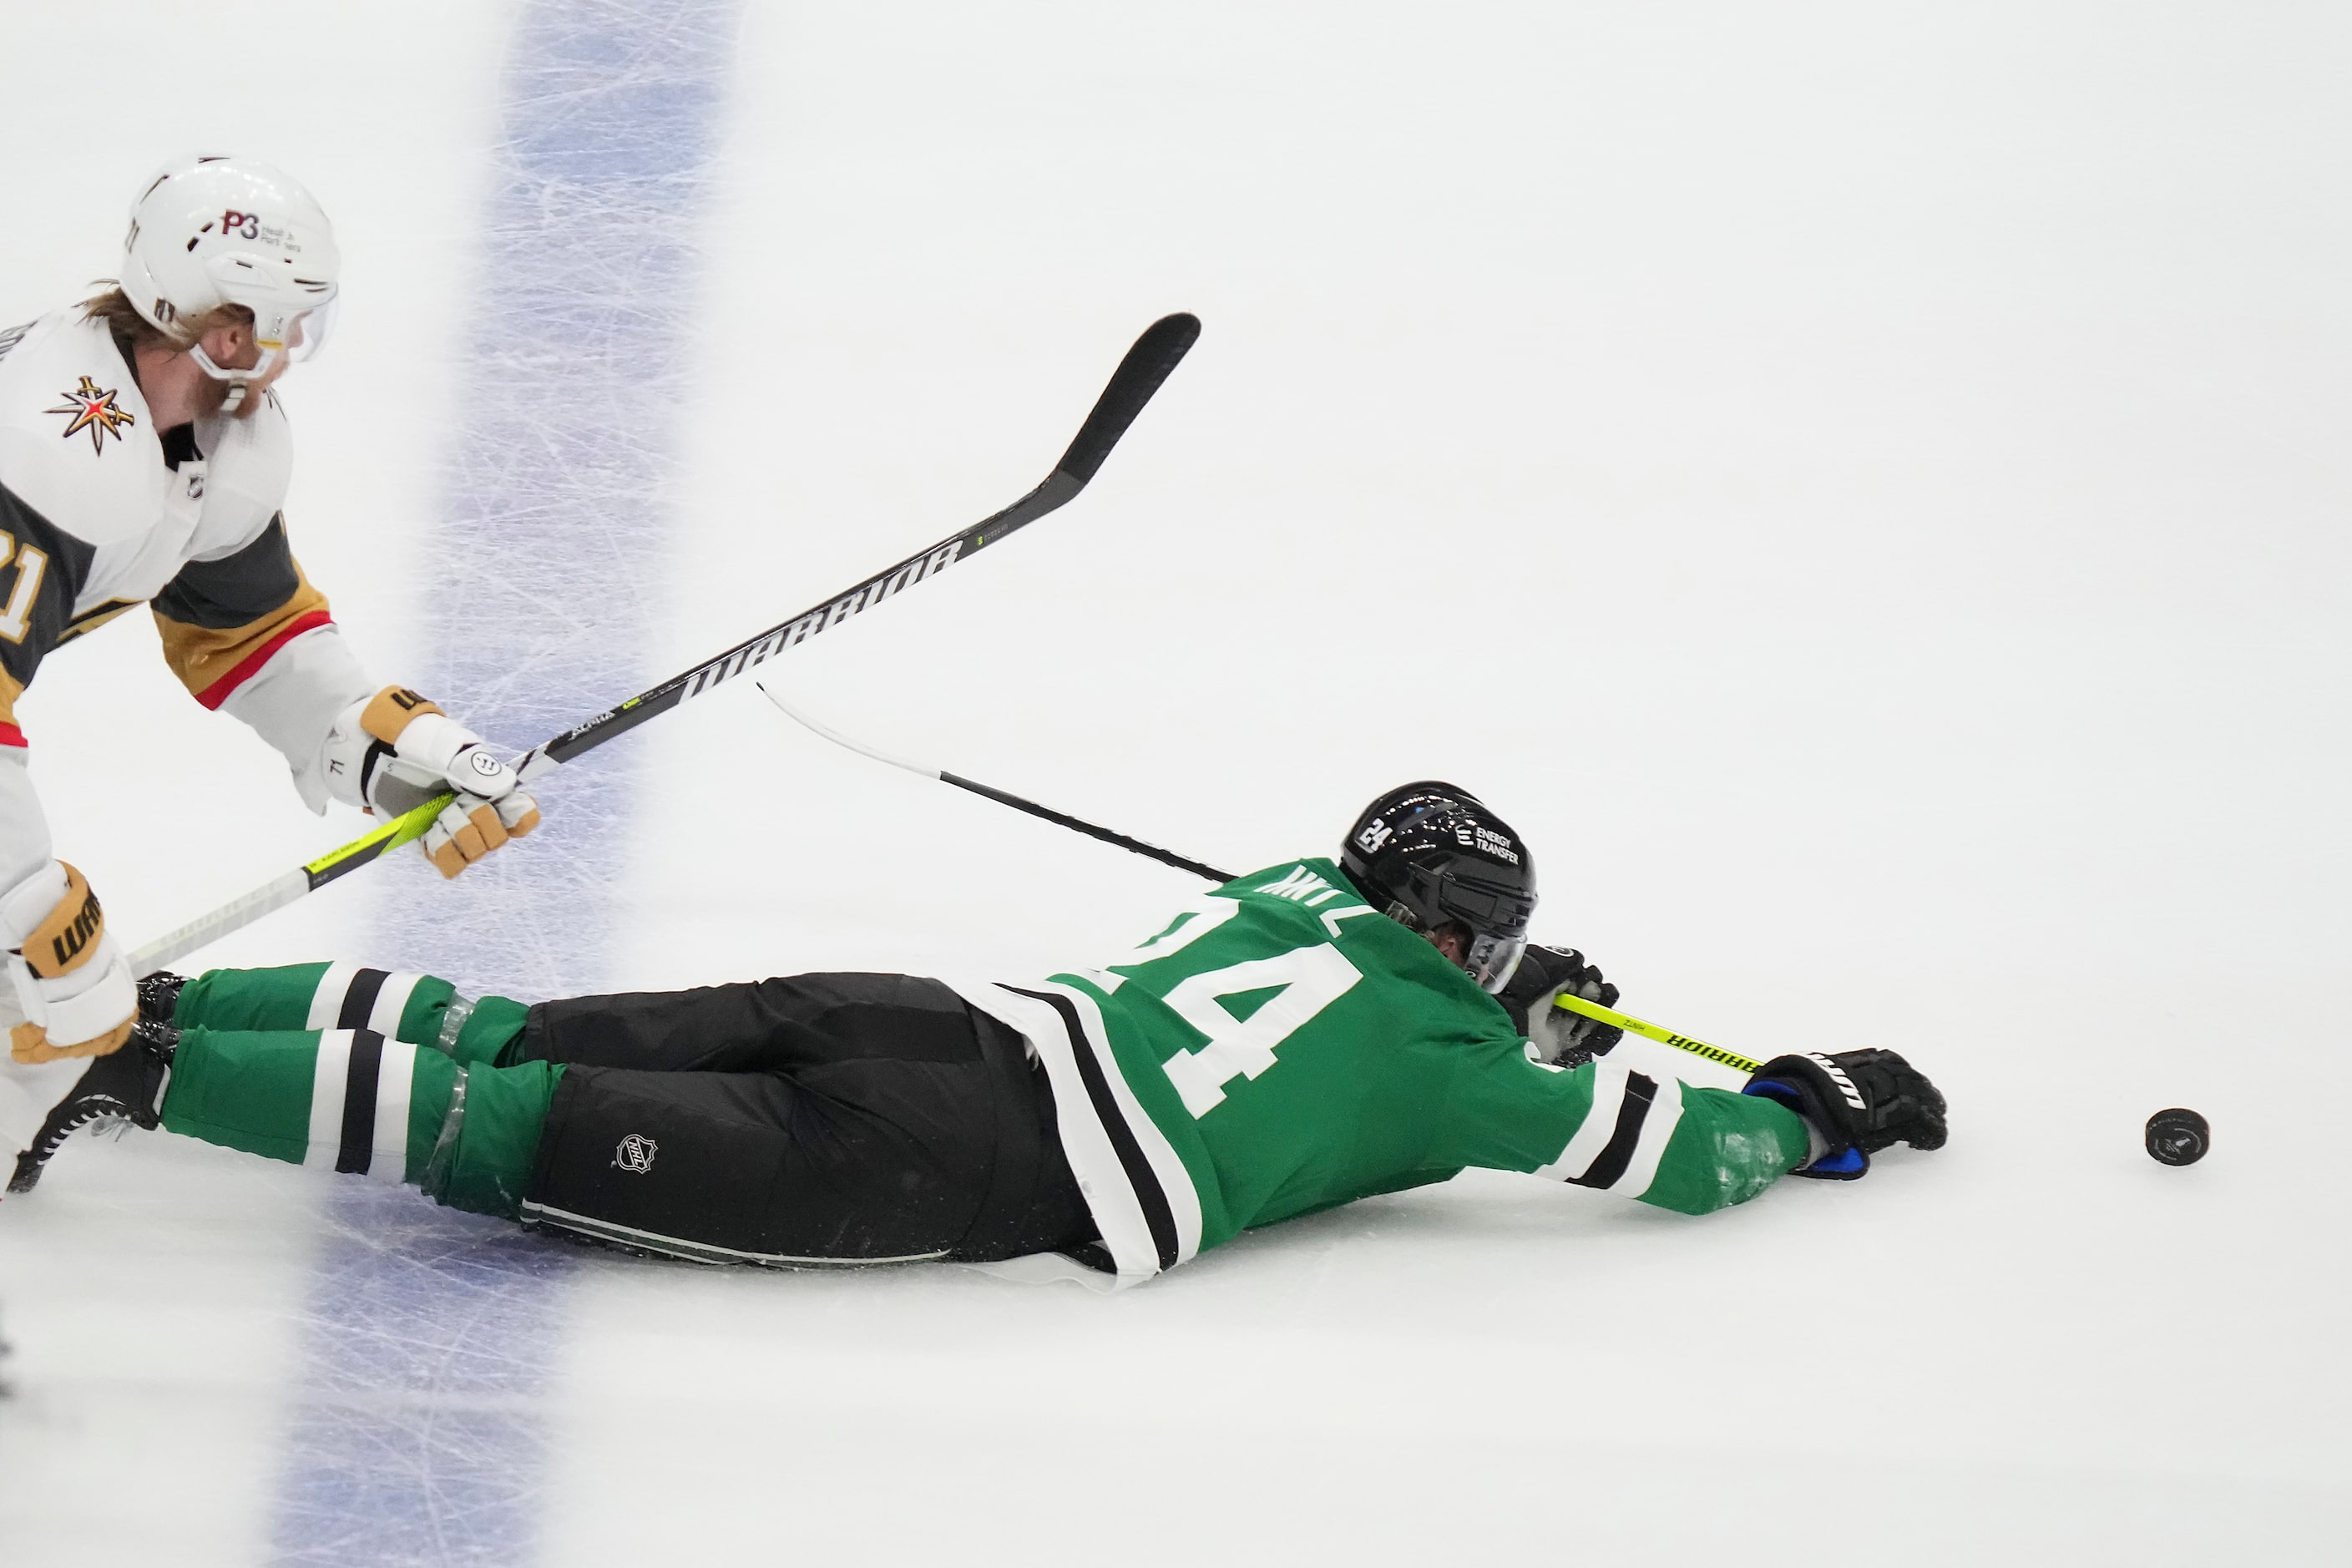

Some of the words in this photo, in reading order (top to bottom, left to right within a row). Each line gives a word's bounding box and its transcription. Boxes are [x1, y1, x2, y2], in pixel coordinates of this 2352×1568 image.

[222, 209, 260, 240] P3
[677, 539, 964, 705] WARRIOR
[1359, 818, 1393, 851] 24
[1475, 827, 1511, 849] ENERGY
[1475, 837, 1519, 865] TRANSFER
[628, 1141, 644, 1166] NHL
